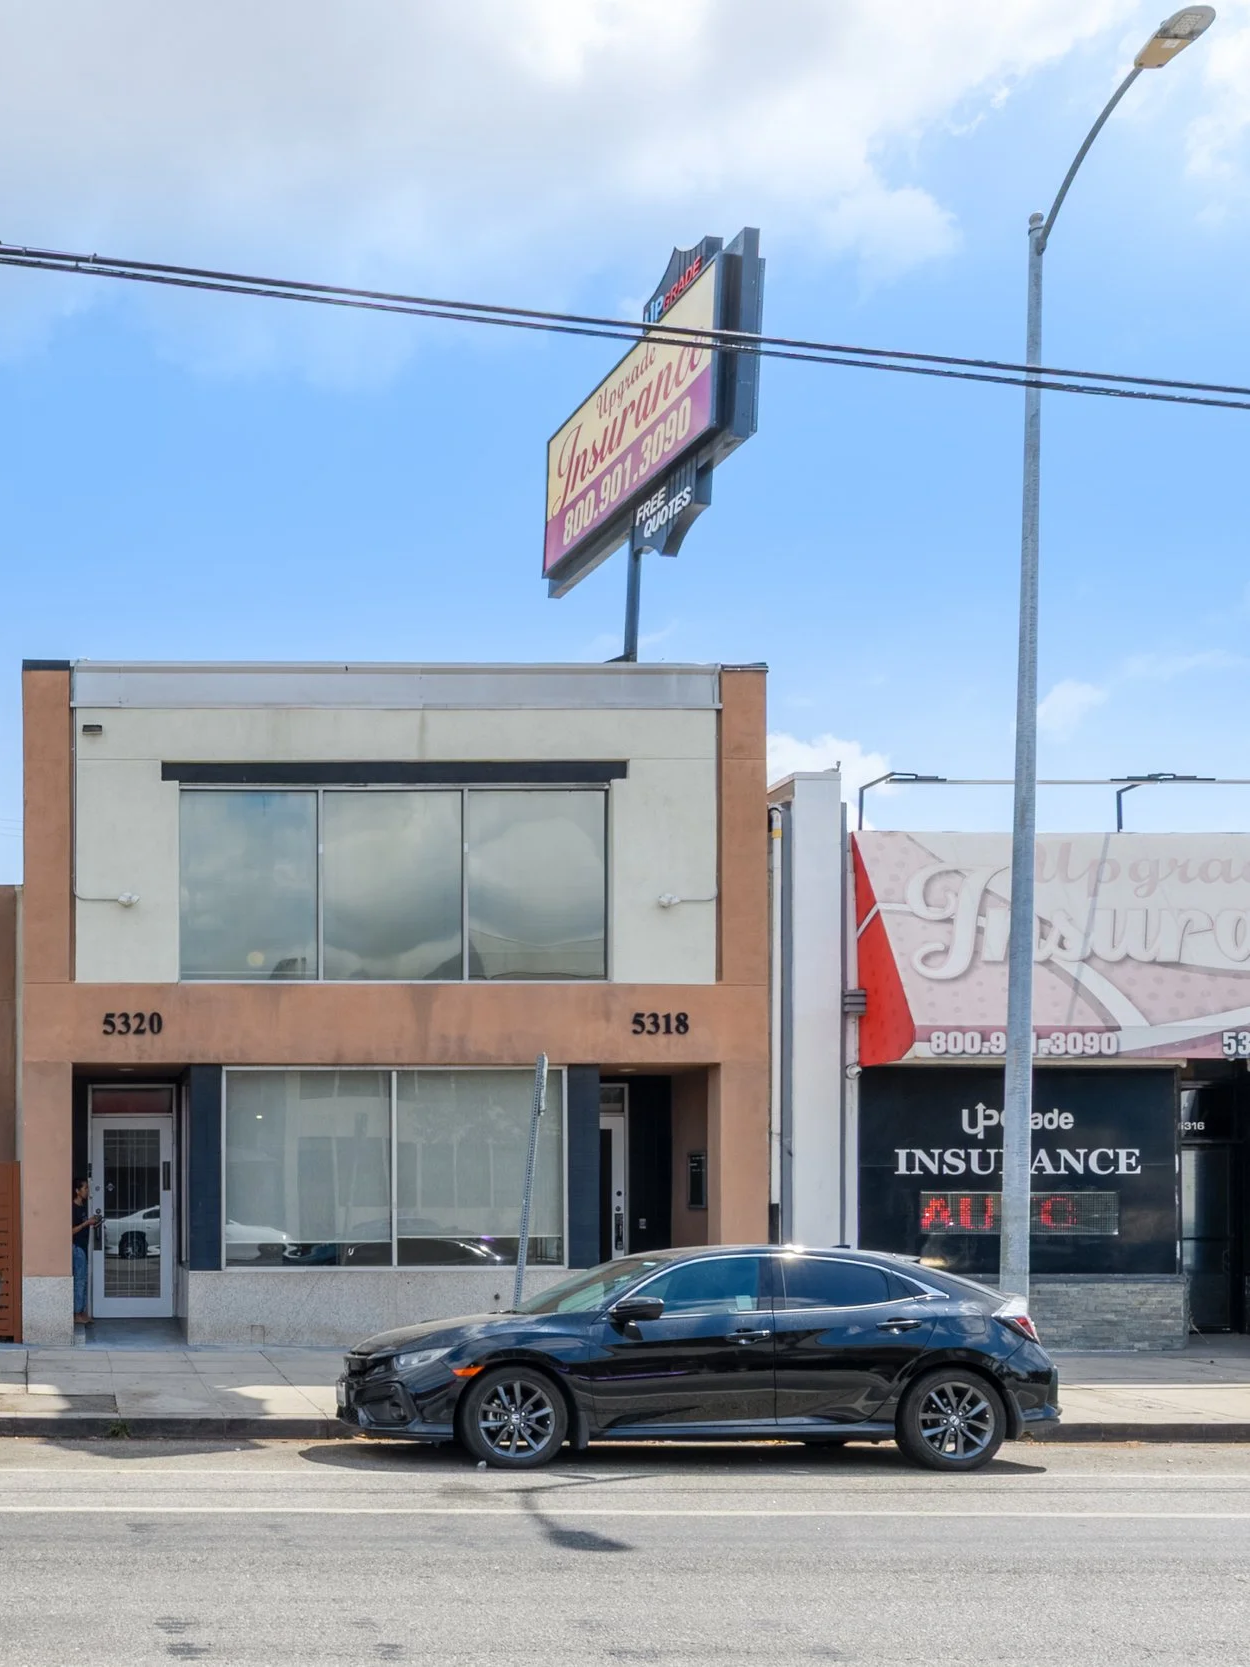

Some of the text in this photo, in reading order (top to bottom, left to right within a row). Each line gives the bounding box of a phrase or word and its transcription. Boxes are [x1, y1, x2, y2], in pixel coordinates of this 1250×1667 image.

[596, 341, 656, 419] Upgrade
[552, 336, 704, 518] Insurance
[562, 395, 693, 546] 800.901.3090
[635, 486, 666, 527] FREE
[643, 486, 693, 539] QUOTES
[1035, 842, 1250, 898] Upgra
[102, 1011, 163, 1035] 5320
[632, 1012, 689, 1035] 5318
[929, 1031, 1118, 1055] 800.91.3090
[894, 1148, 1142, 1175] INSUANCE
